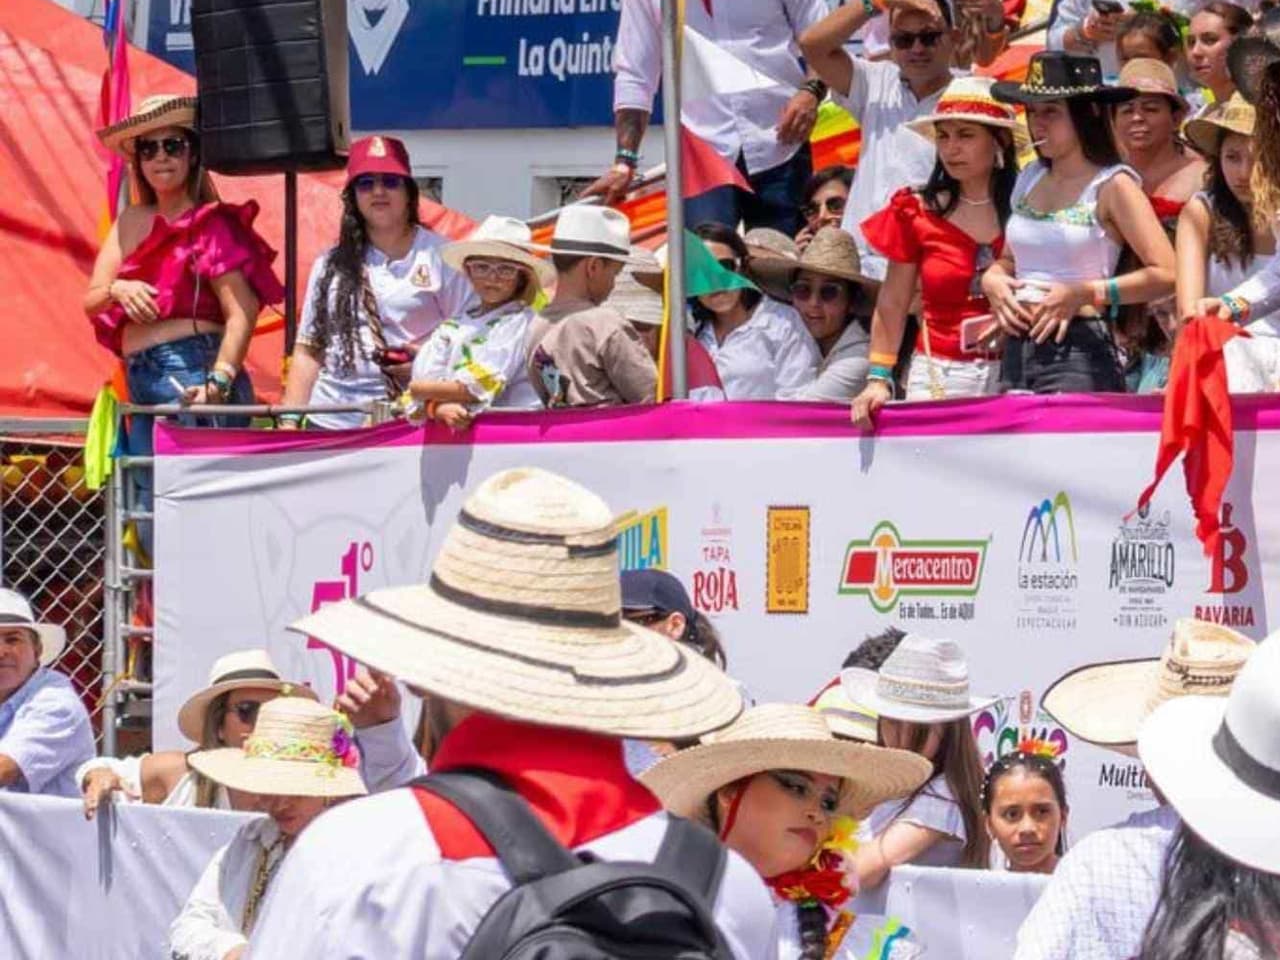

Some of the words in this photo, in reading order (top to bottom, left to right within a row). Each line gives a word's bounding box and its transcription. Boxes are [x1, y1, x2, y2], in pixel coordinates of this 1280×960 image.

[518, 38, 545, 76] La
[616, 514, 662, 572] UILA
[703, 545, 730, 563] TAPA
[876, 548, 972, 588] Mercacentro
[1018, 566, 1028, 589] la
[1031, 567, 1078, 589] estación
[1108, 541, 1174, 589] AMARILLO
[693, 566, 739, 612] ROJA
[1194, 605, 1254, 627] BAVARIA
